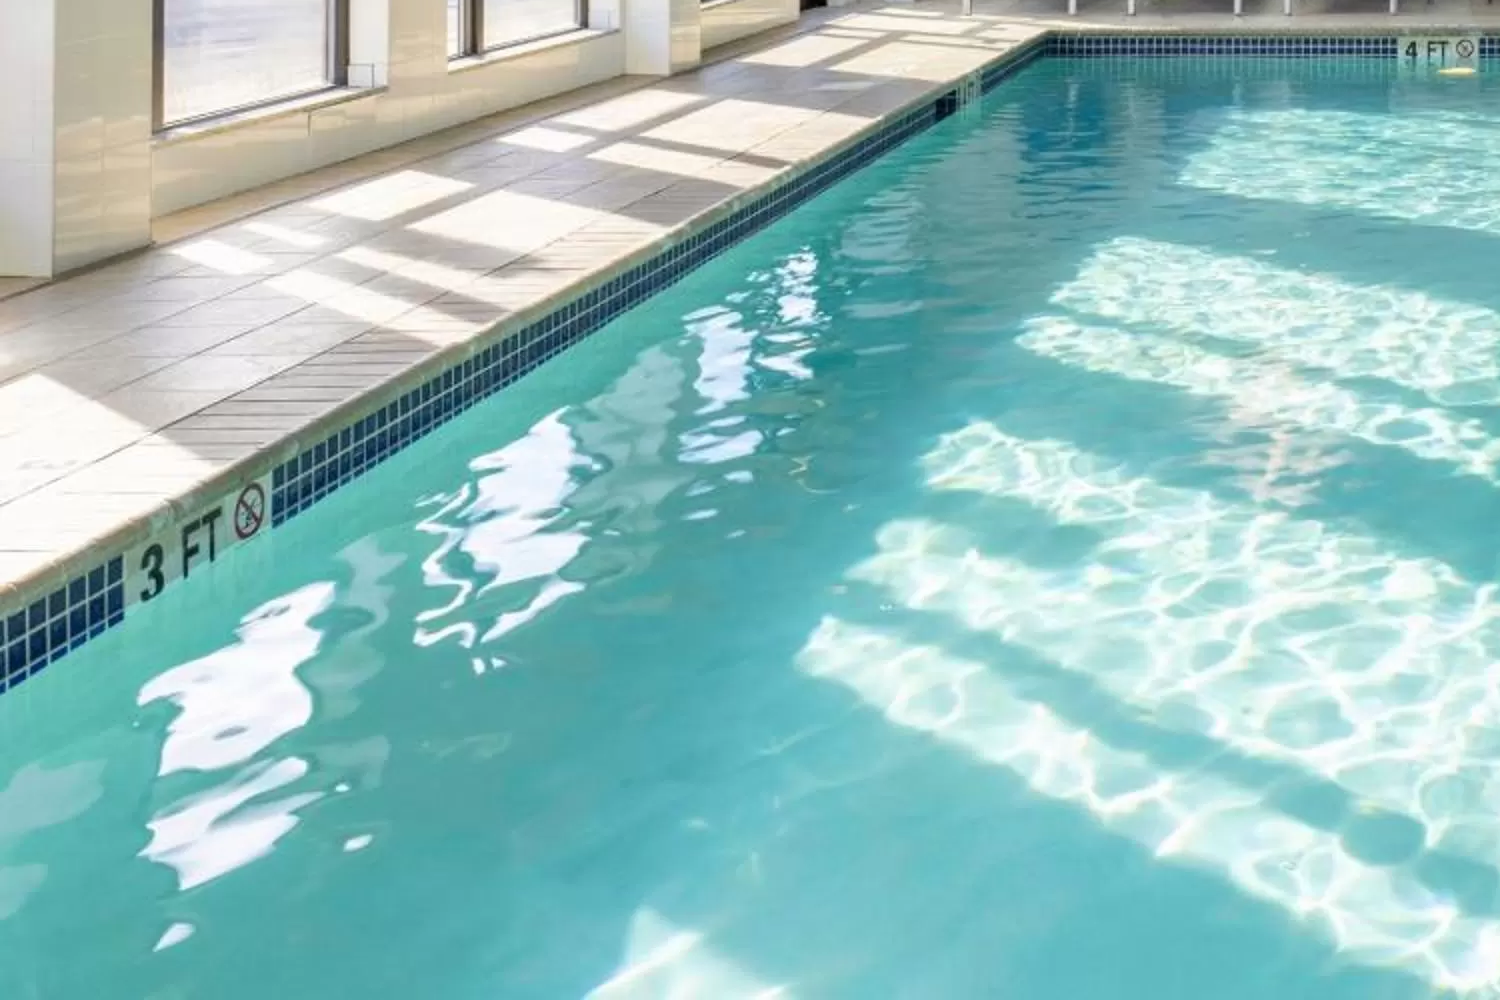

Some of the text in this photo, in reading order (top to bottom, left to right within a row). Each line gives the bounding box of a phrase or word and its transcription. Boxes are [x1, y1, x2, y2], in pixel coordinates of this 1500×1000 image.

[1405, 41, 1449, 58] 4 FT
[140, 506, 222, 602] 3 FT
